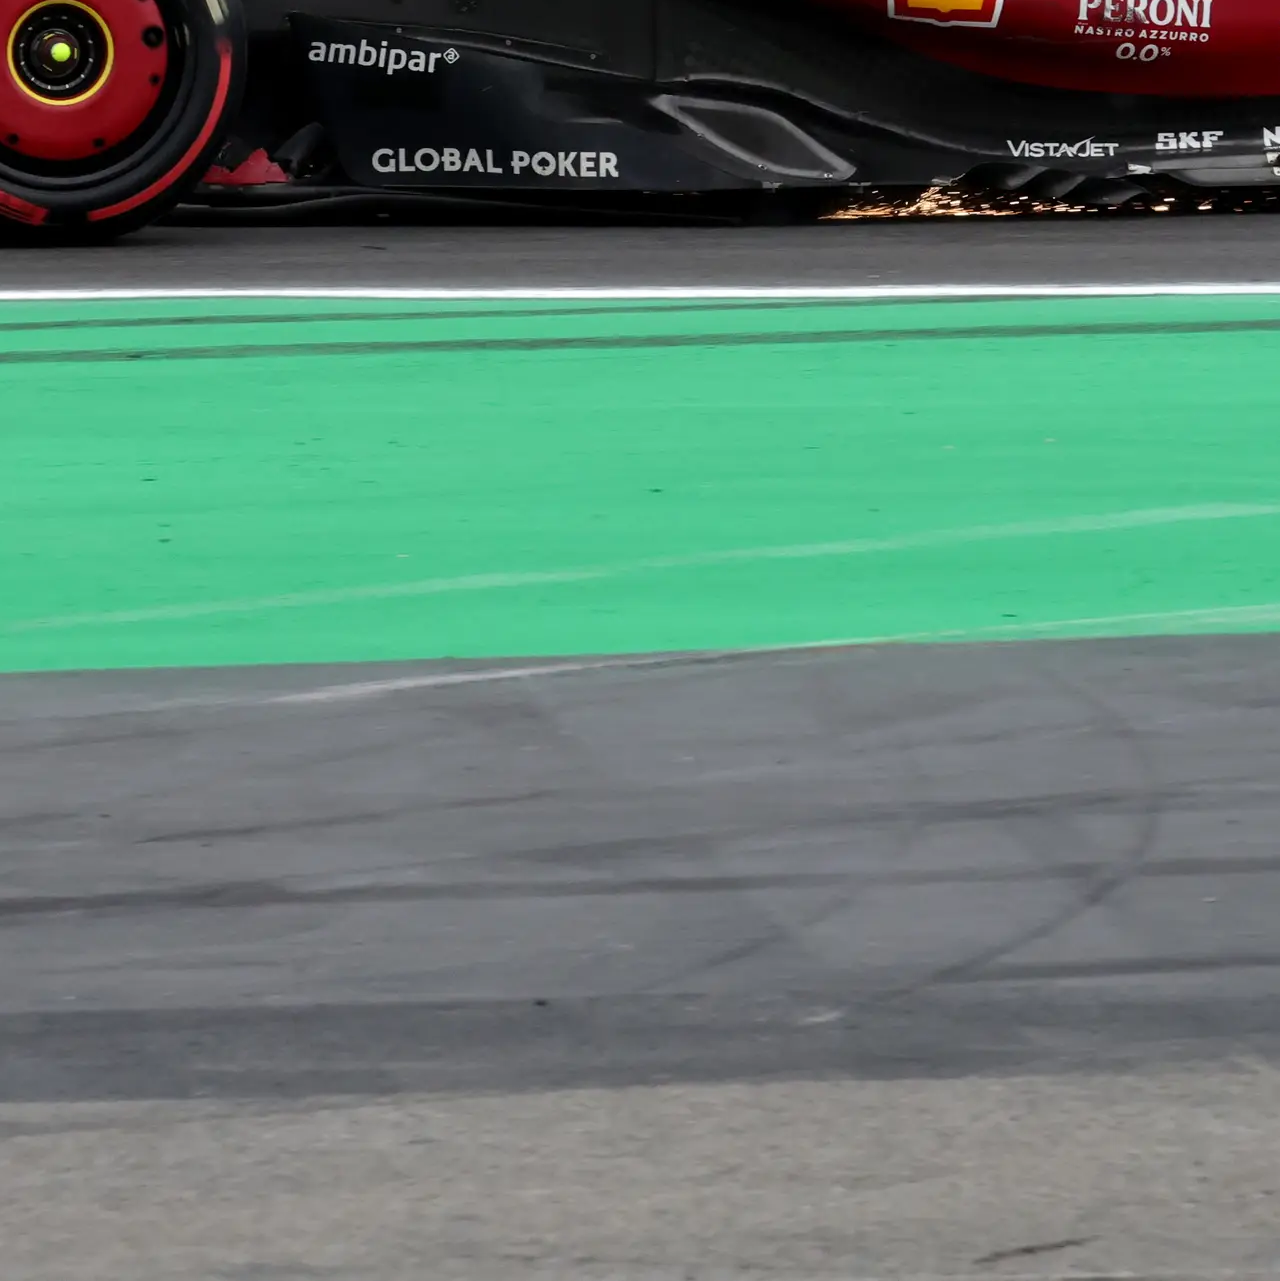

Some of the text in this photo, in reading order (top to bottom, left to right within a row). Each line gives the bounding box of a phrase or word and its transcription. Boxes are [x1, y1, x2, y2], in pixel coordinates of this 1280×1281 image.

[1139, 29, 1209, 43] AZZURRO
[308, 39, 442, 75] ambipar
[1116, 42, 1172, 62] 0.0%
[1155, 130, 1224, 150] SKF
[372, 148, 619, 177] GLOBAL POKER
